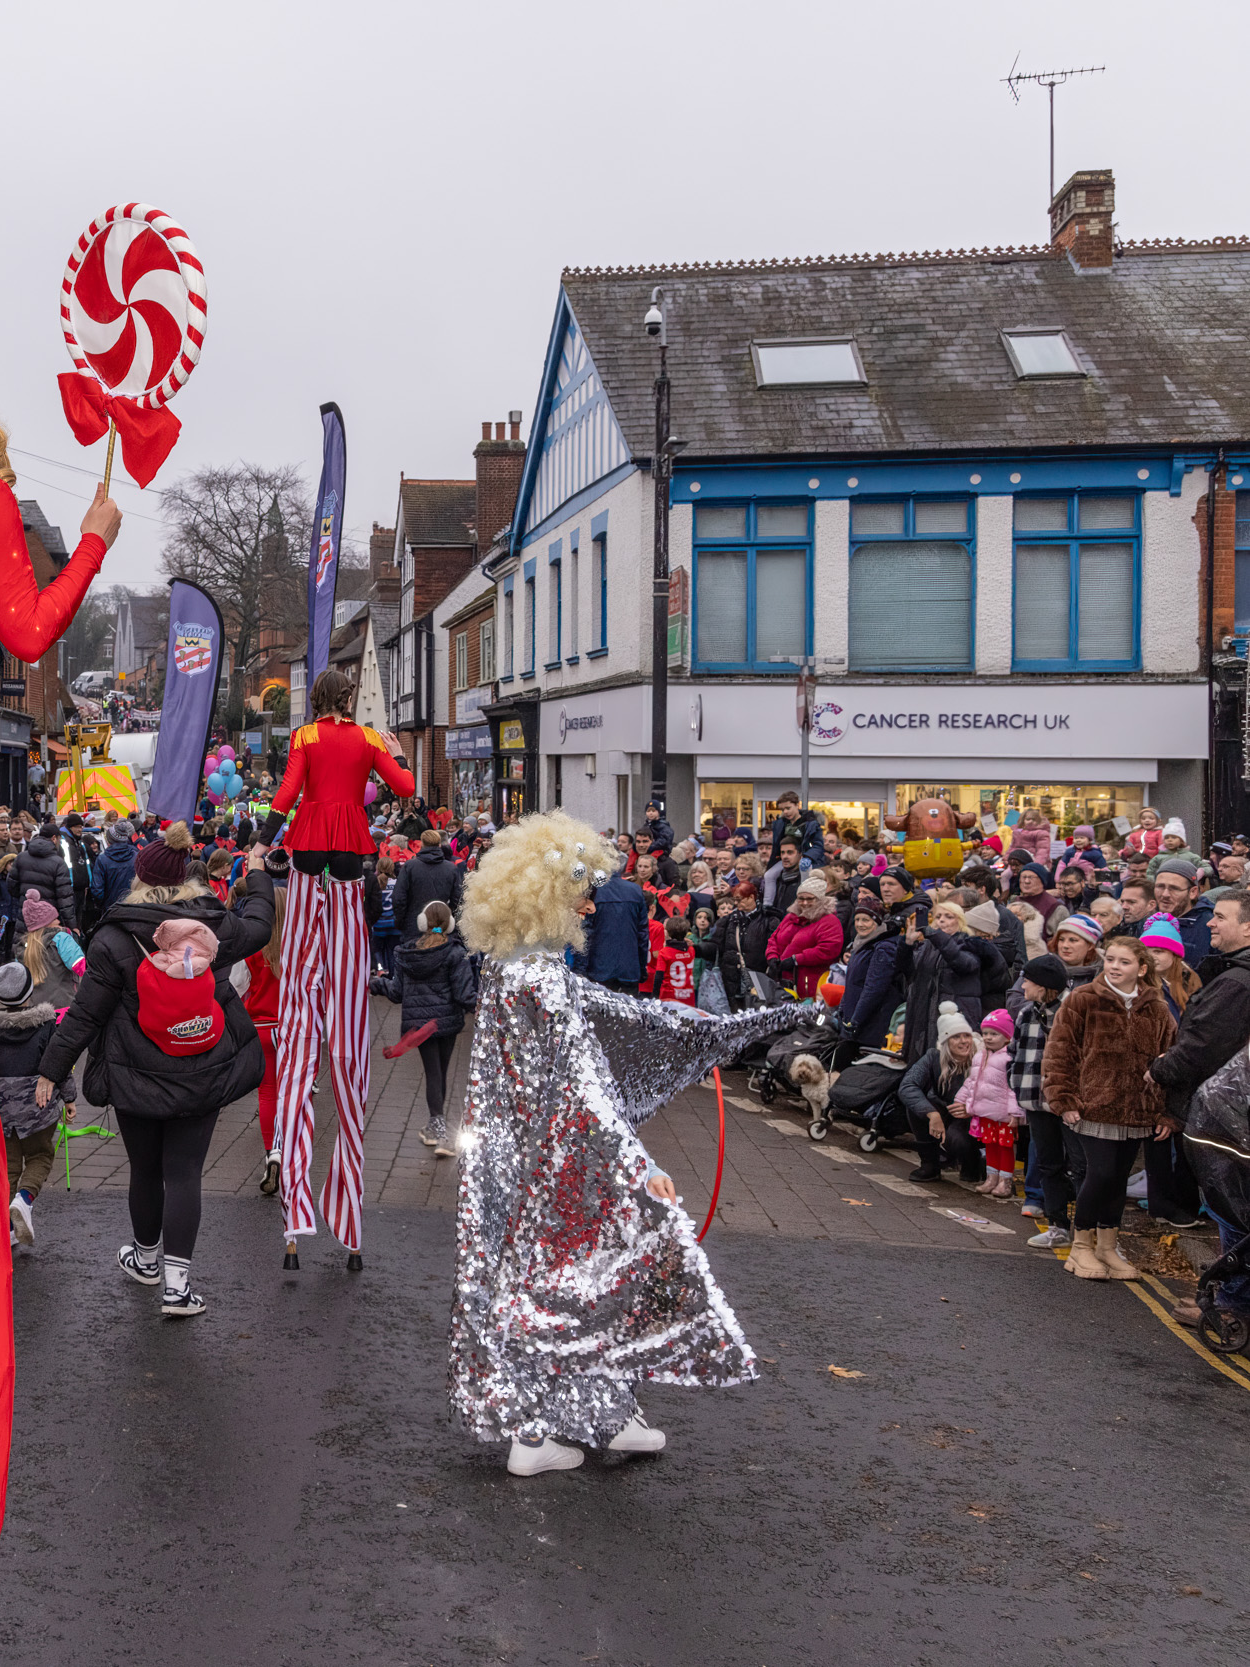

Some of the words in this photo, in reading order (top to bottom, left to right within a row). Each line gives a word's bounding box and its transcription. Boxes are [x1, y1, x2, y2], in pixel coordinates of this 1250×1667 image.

[852, 713, 930, 729] CANCER
[938, 713, 1038, 729] RESEARCH
[1044, 714, 1070, 730] UK
